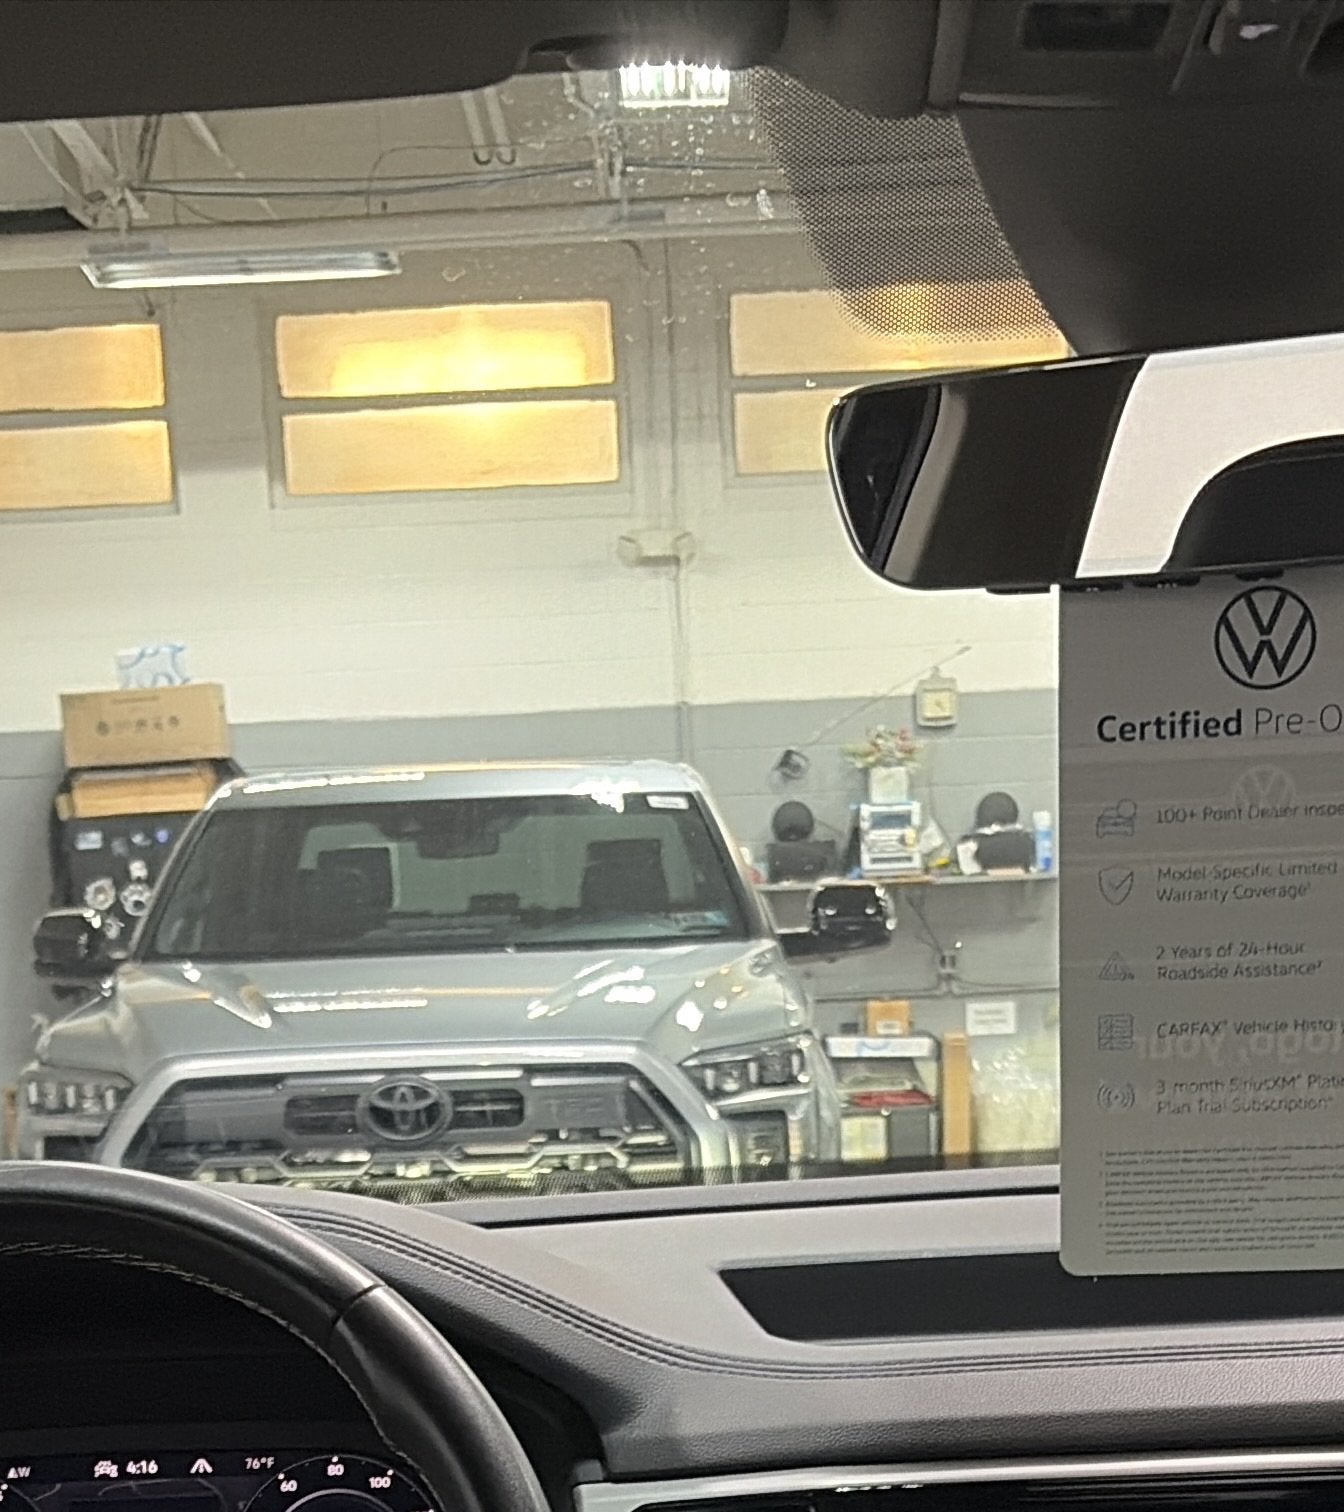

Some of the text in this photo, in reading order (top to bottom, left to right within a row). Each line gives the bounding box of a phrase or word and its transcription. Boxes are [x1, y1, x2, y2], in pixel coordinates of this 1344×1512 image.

[1096, 708, 1243, 743] Certified
[1155, 806, 1198, 824] 100+
[1202, 805, 1243, 822] Point
[1278, 861, 1338, 876] Limited
[1155, 886, 1229, 904] Warranty
[1155, 941, 1305, 960] 2 Years of 24-Hour
[1157, 963, 1229, 981] Roadside
[1233, 1017, 1288, 1035] Vehicle
[1156, 1099, 1192, 1115] Plan
[125, 1459, 158, 1476] 4:16
[327, 1463, 344, 1477] 80
[280, 1479, 298, 1493] 60
[368, 1475, 391, 1489] 100
